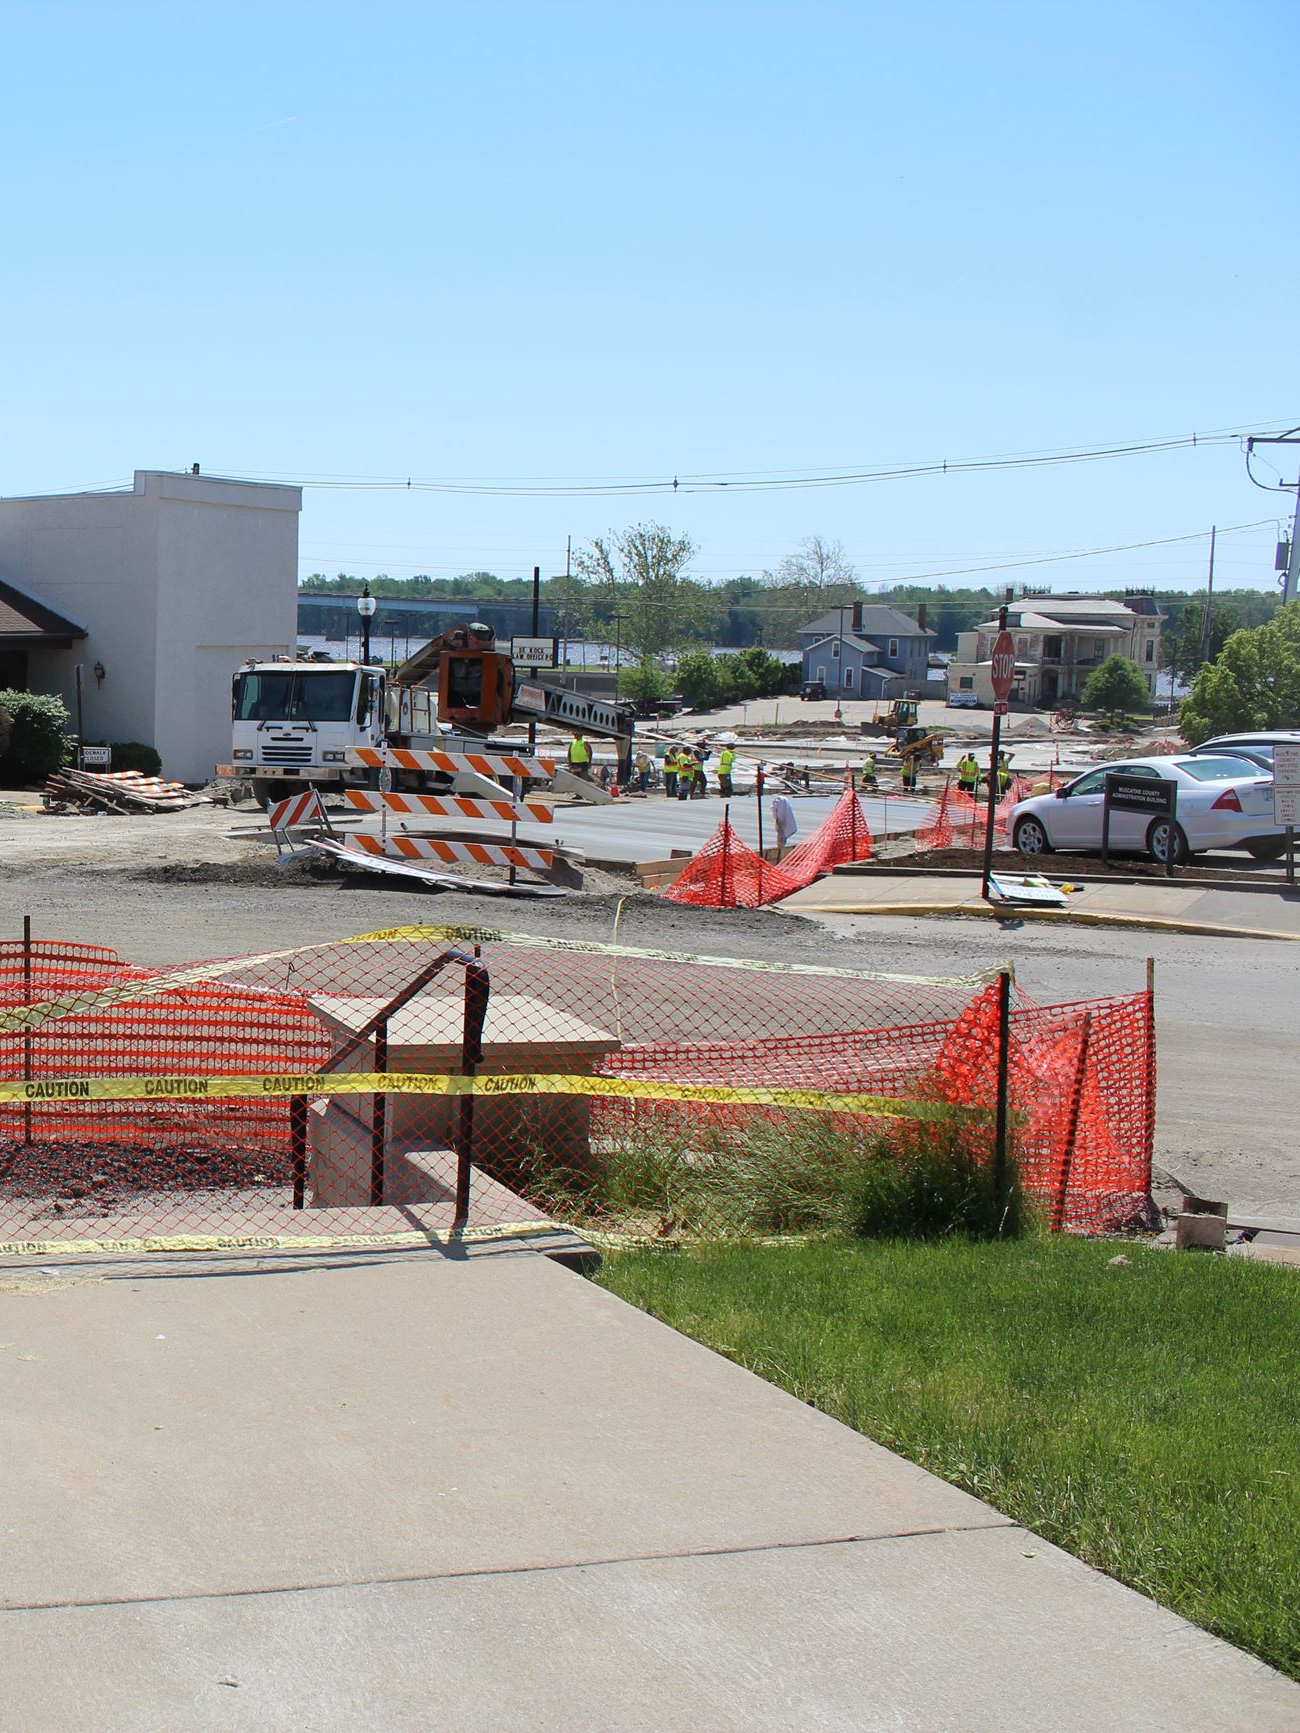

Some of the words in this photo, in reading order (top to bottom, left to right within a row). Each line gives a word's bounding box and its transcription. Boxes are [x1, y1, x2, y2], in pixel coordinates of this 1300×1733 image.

[993, 654, 1014, 678] STOP
[1112, 792, 1146, 801] ADMINISTRATION
[1118, 787, 1142, 795] MUSCATINE
[25, 1081, 89, 1098] CAUTION
[144, 1079, 208, 1094] CAUTION
[262, 1076, 325, 1091] CAUTION
[377, 1074, 438, 1090] CAUTION
[484, 1077, 536, 1092] CAUTION
[216, 1237, 279, 1249] CAUTION
